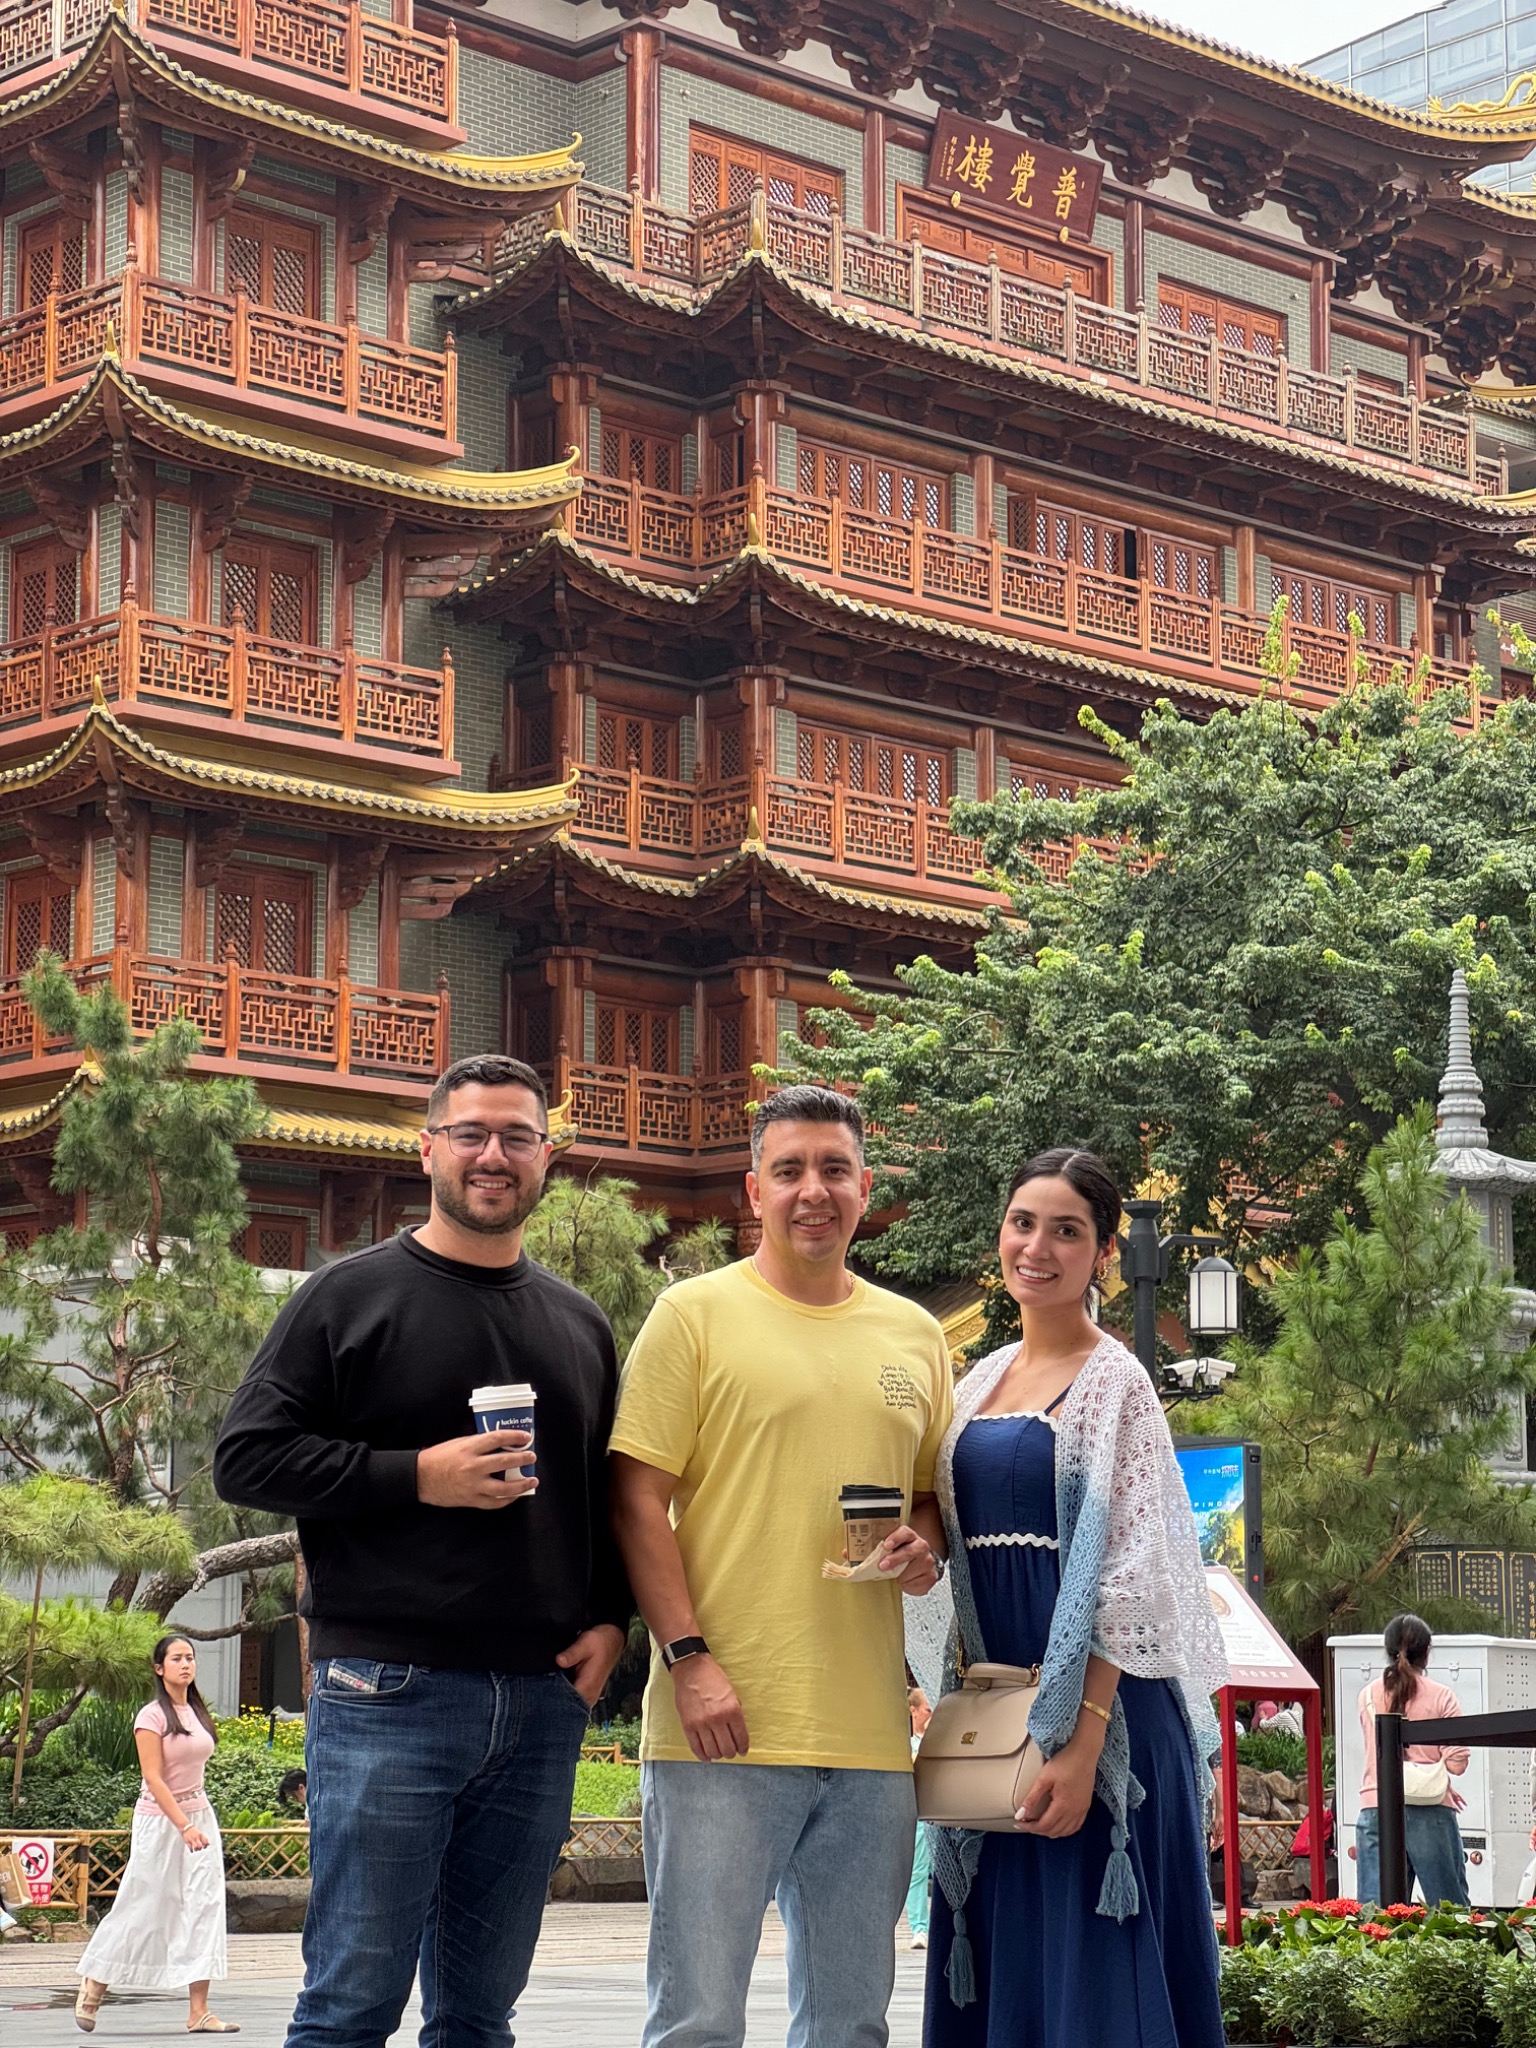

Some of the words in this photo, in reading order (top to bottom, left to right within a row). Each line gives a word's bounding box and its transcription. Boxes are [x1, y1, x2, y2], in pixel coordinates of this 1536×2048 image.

[954, 134, 1078, 221] 普覺樓
[501, 1417, 519, 1426] luckin
